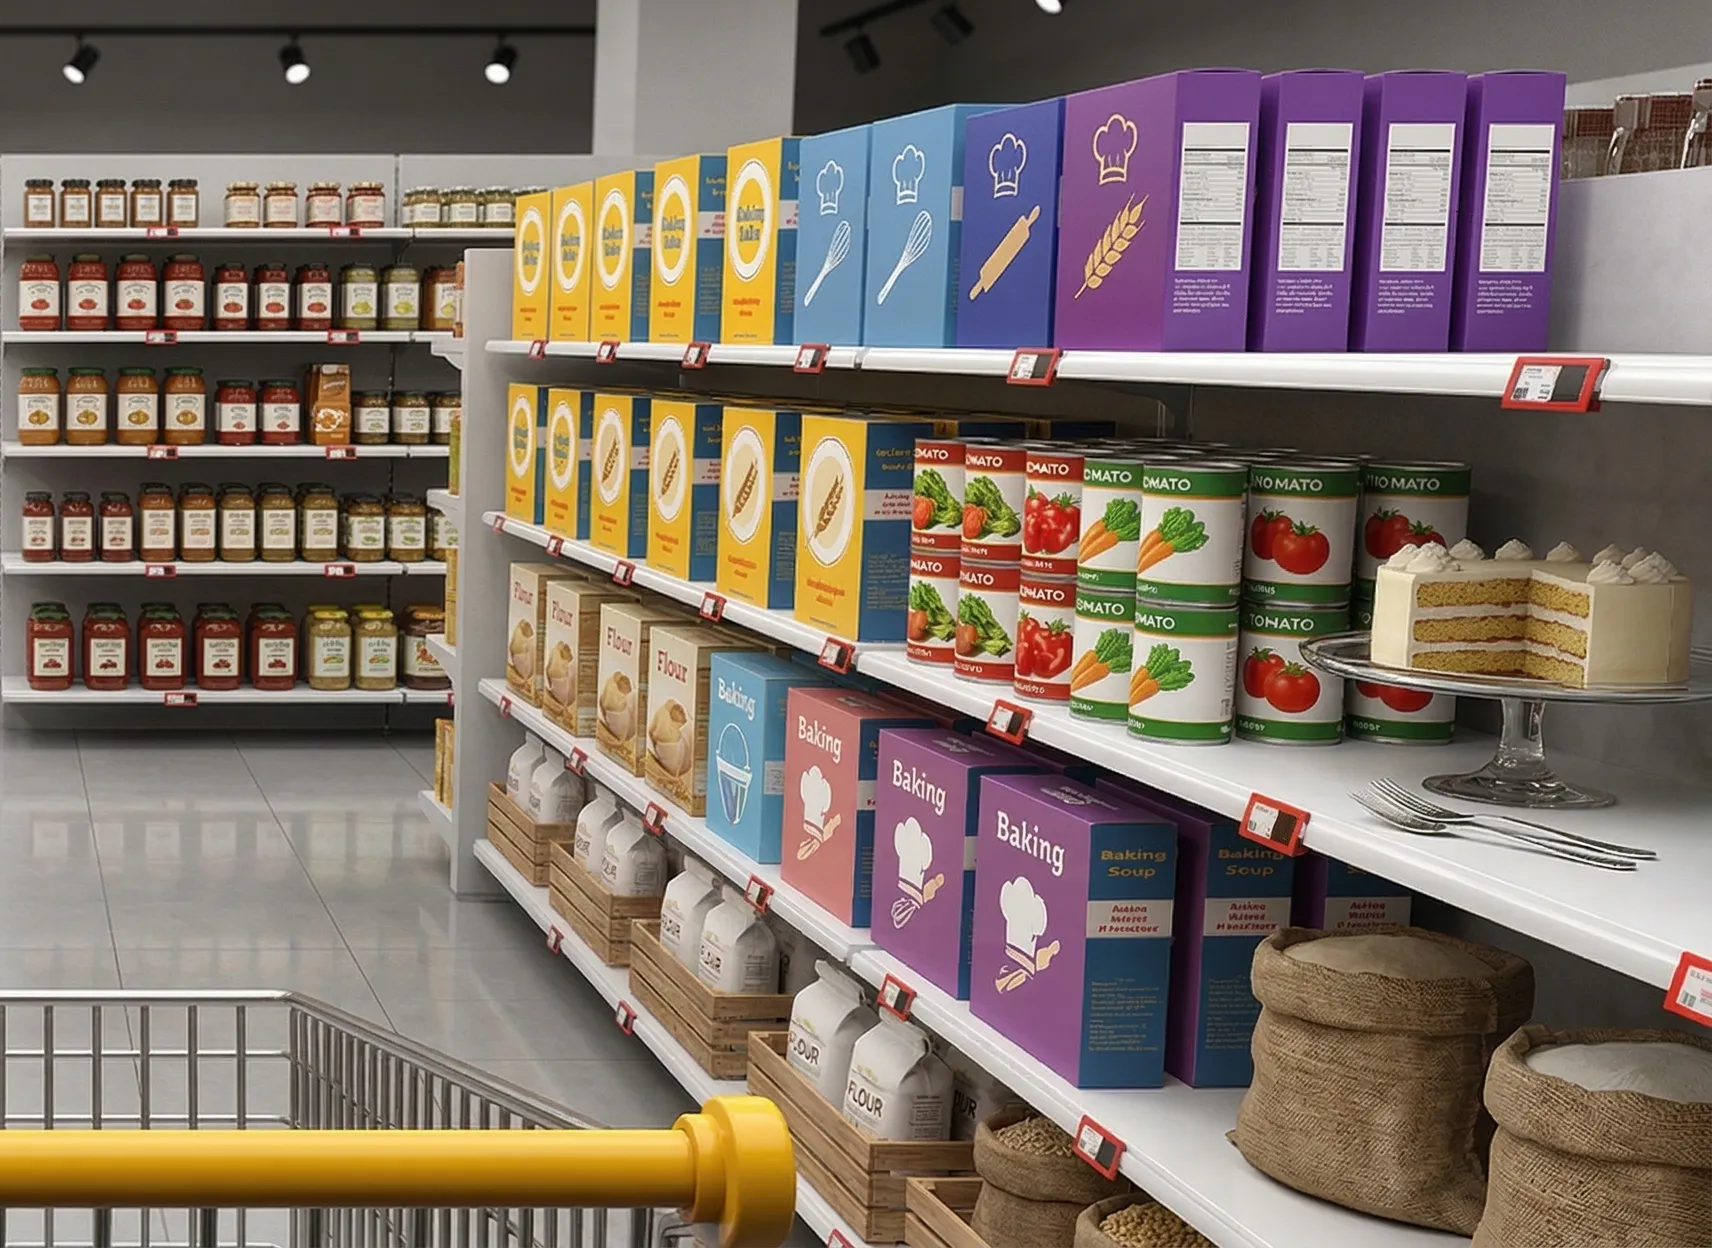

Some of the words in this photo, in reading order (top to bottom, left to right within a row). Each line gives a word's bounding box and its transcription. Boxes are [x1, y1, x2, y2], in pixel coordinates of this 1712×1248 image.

[607, 626, 633, 657] Flour
[657, 649, 688, 684] Flour
[717, 677, 756, 722] Baking
[798, 715, 842, 764] Baking
[892, 759, 947, 817] Baking
[995, 810, 1065, 878] Baking
[1101, 849, 1167, 863] Baking
[1107, 867, 1156, 880] Soup
[1225, 865, 1274, 878] Soup
[847, 1079, 883, 1119] FLOUR
